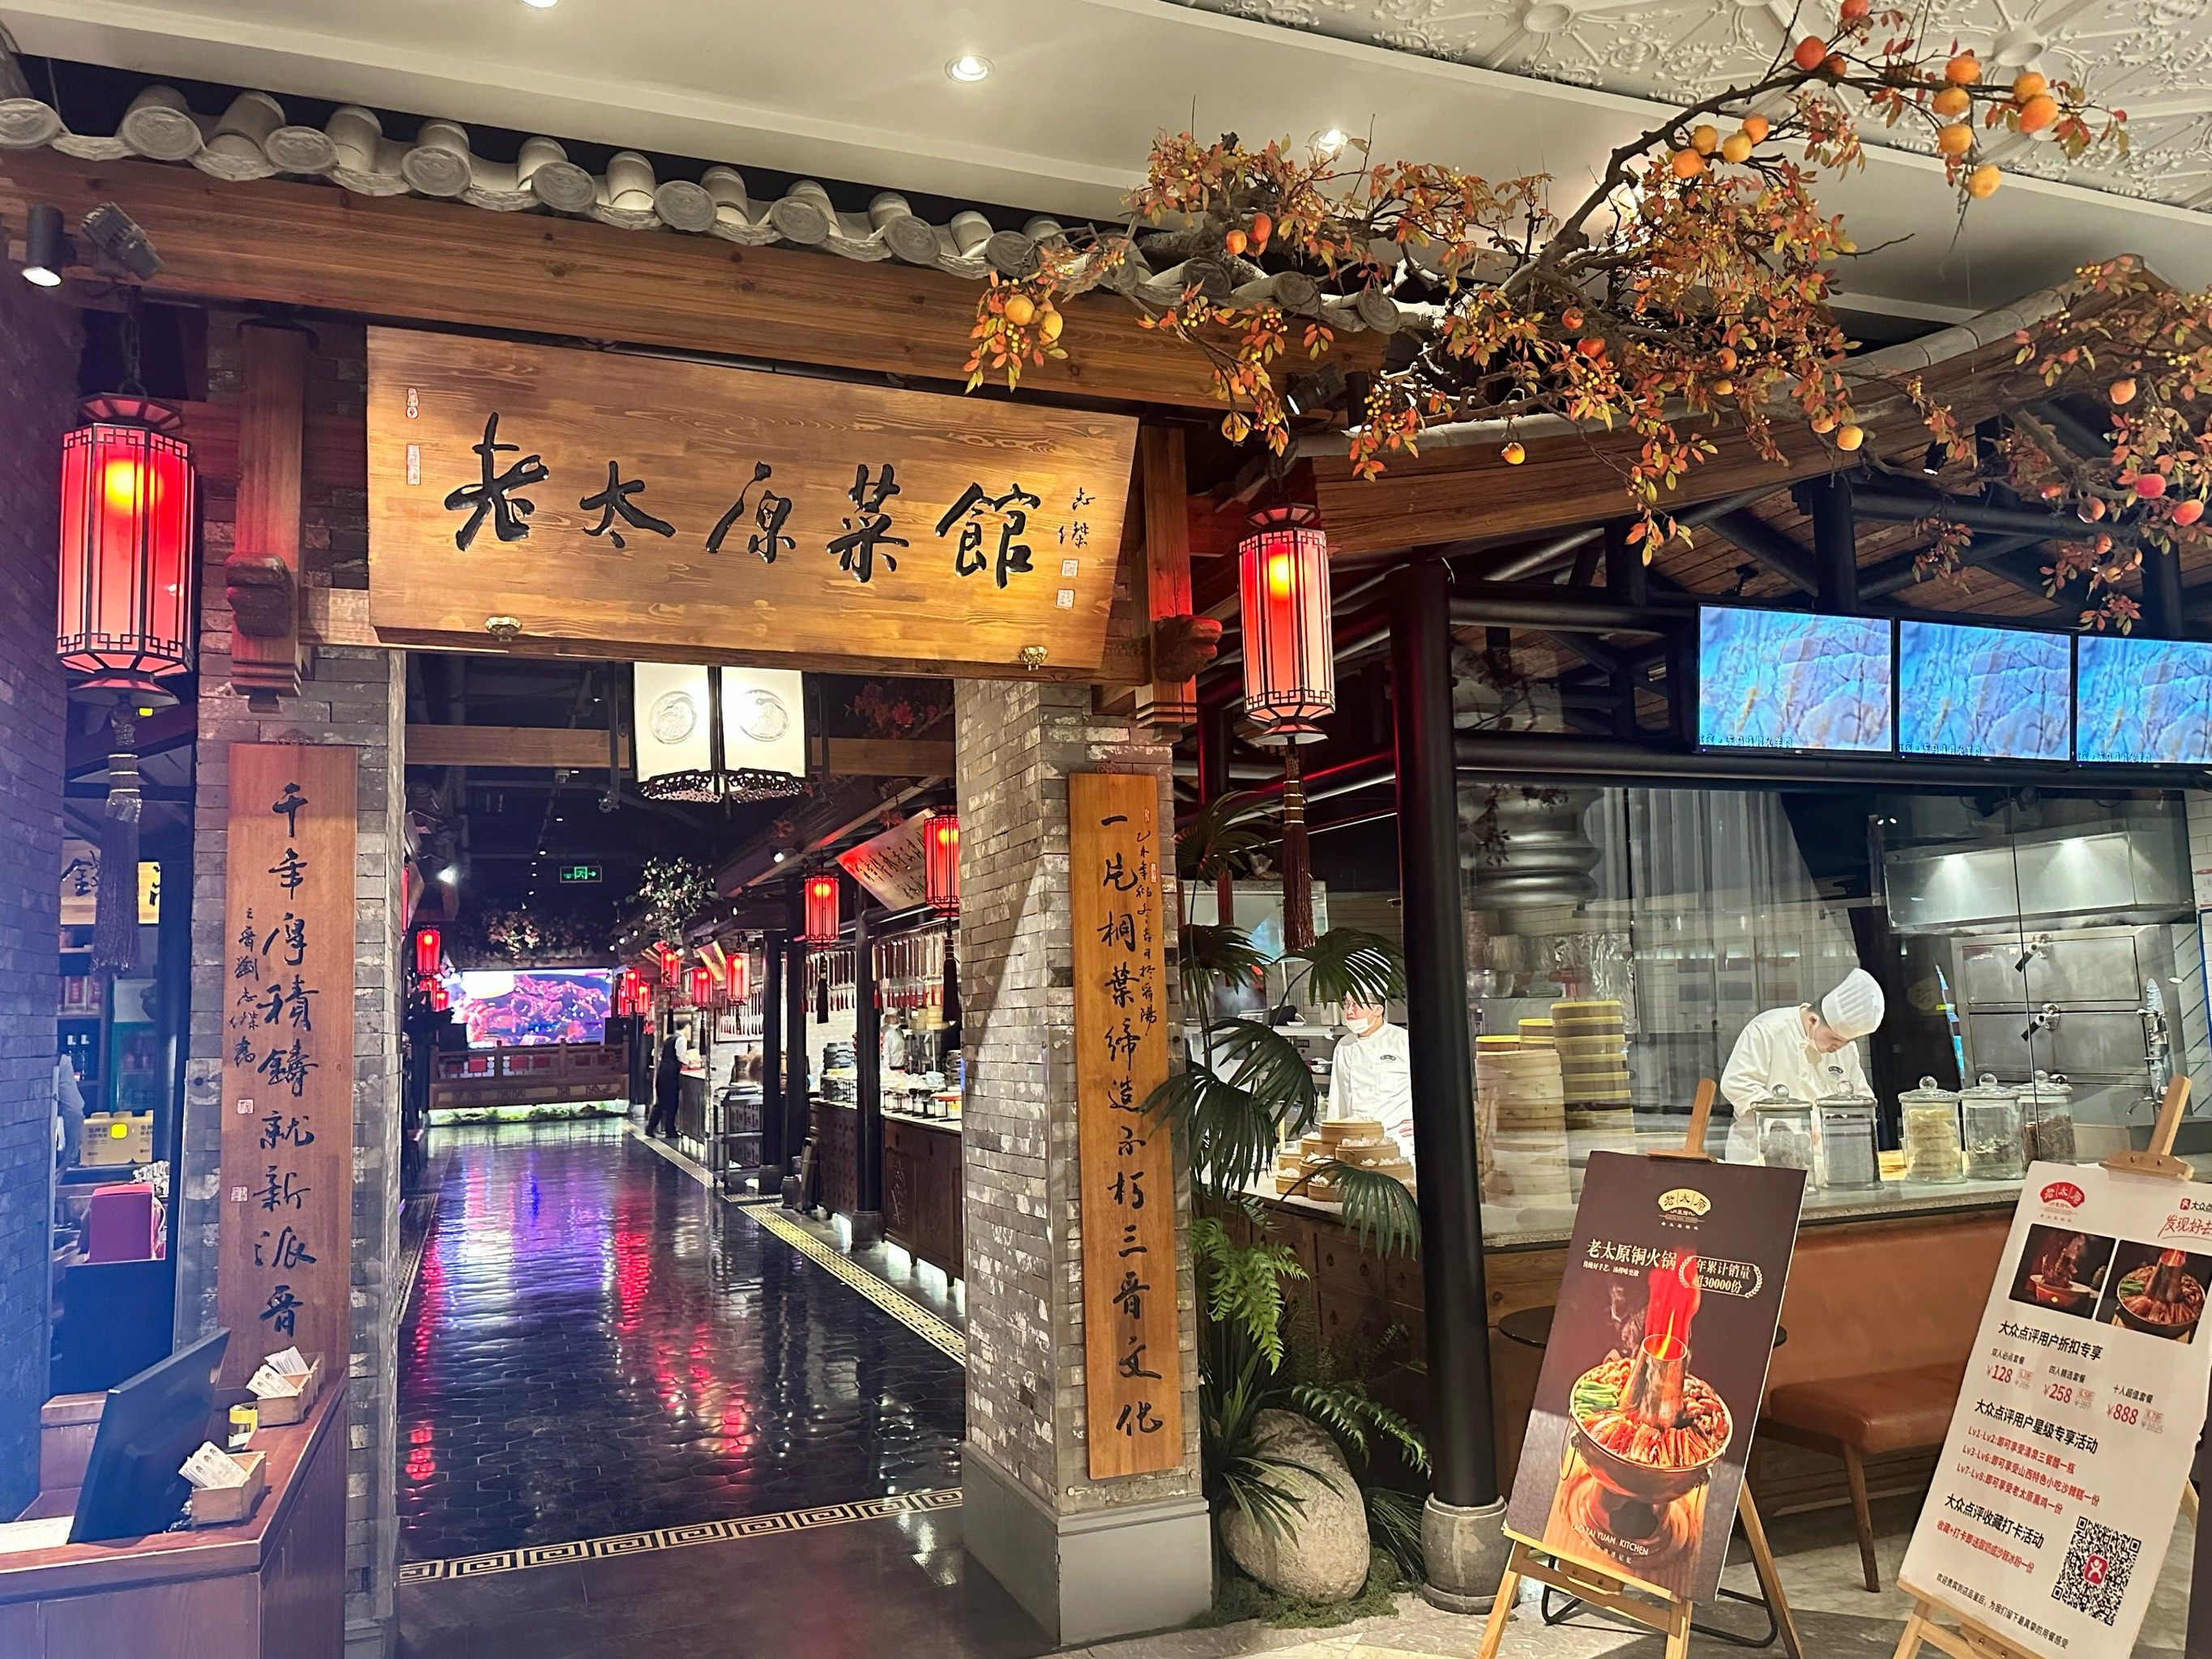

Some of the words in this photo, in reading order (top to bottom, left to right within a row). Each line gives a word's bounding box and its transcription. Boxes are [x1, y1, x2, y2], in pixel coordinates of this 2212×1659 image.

[1663, 1193, 1707, 1211] 老太原
[2044, 1186, 2082, 1205] 老太原
[1586, 1239, 1678, 1271] 老太原铜火锅
[1998, 1320, 2104, 1361] 大众点评用户折扣专享
[1975, 1399, 2099, 1455] 大众点评用户星级专享活动
[1944, 1493, 2045, 1550] 大众点评收藏打卡活动
[1596, 1530, 1616, 1545] YUAN
[1620, 1538, 1649, 1556] KITCHEN
